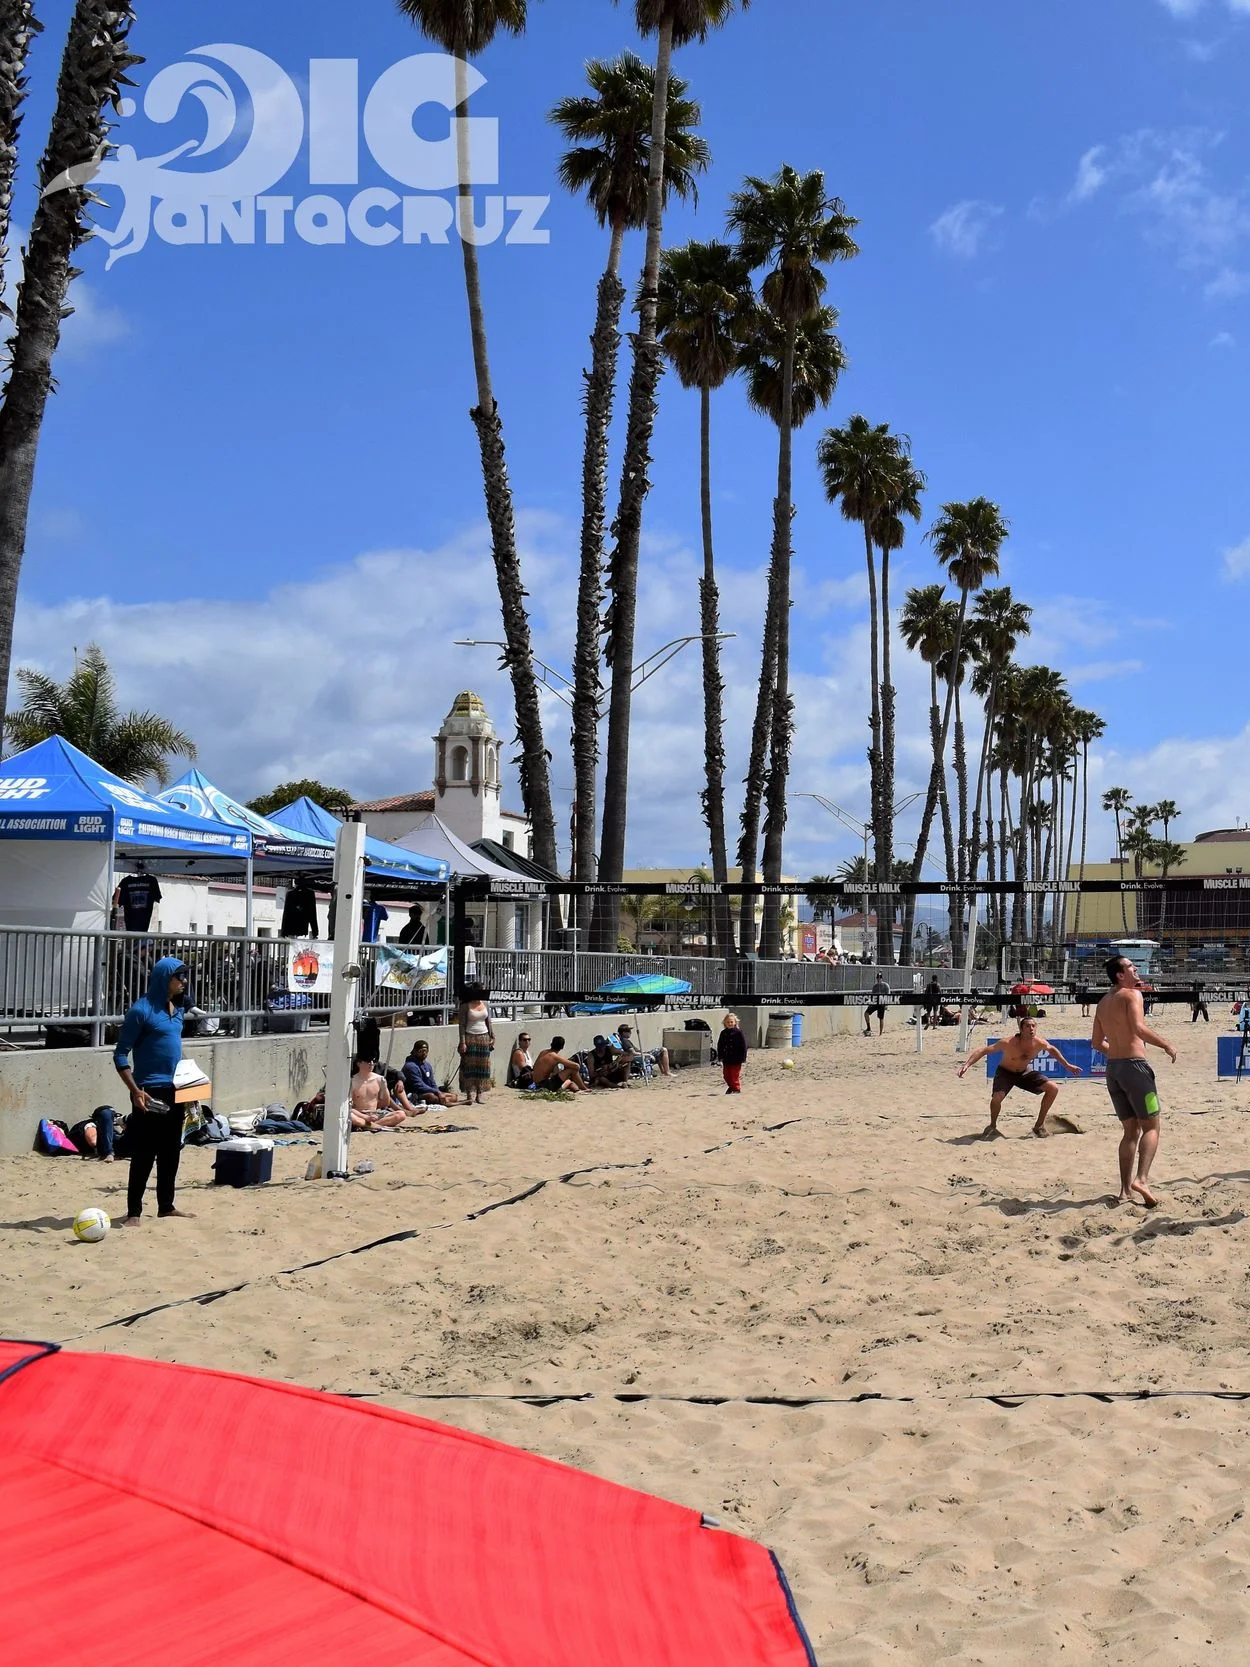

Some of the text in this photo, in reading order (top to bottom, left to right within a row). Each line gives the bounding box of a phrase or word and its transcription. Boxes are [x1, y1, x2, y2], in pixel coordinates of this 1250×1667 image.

[0, 778, 47, 789] UD
[7, 819, 67, 830] ASSOCIATION
[78, 816, 103, 825] BUD
[73, 825, 107, 833] LIGHT
[117, 826, 135, 836] LIGHT
[491, 883, 546, 893] MUSCLE MILK
[666, 884, 722, 894] MUSCLE MILK
[843, 883, 901, 893] MUSCLE MILK
[1023, 881, 1081, 892] MUSCLE MILK
[1203, 879, 1238, 889] MUSCLE
[489, 991, 546, 1000] MUSCLE MILK
[664, 995, 722, 1005] MUSCLE MILK
[843, 995, 900, 1005] MUSCLE MILK
[1020, 994, 1077, 1004] MUSCLE MILK
[1199, 992, 1233, 1002] MUSCLE
